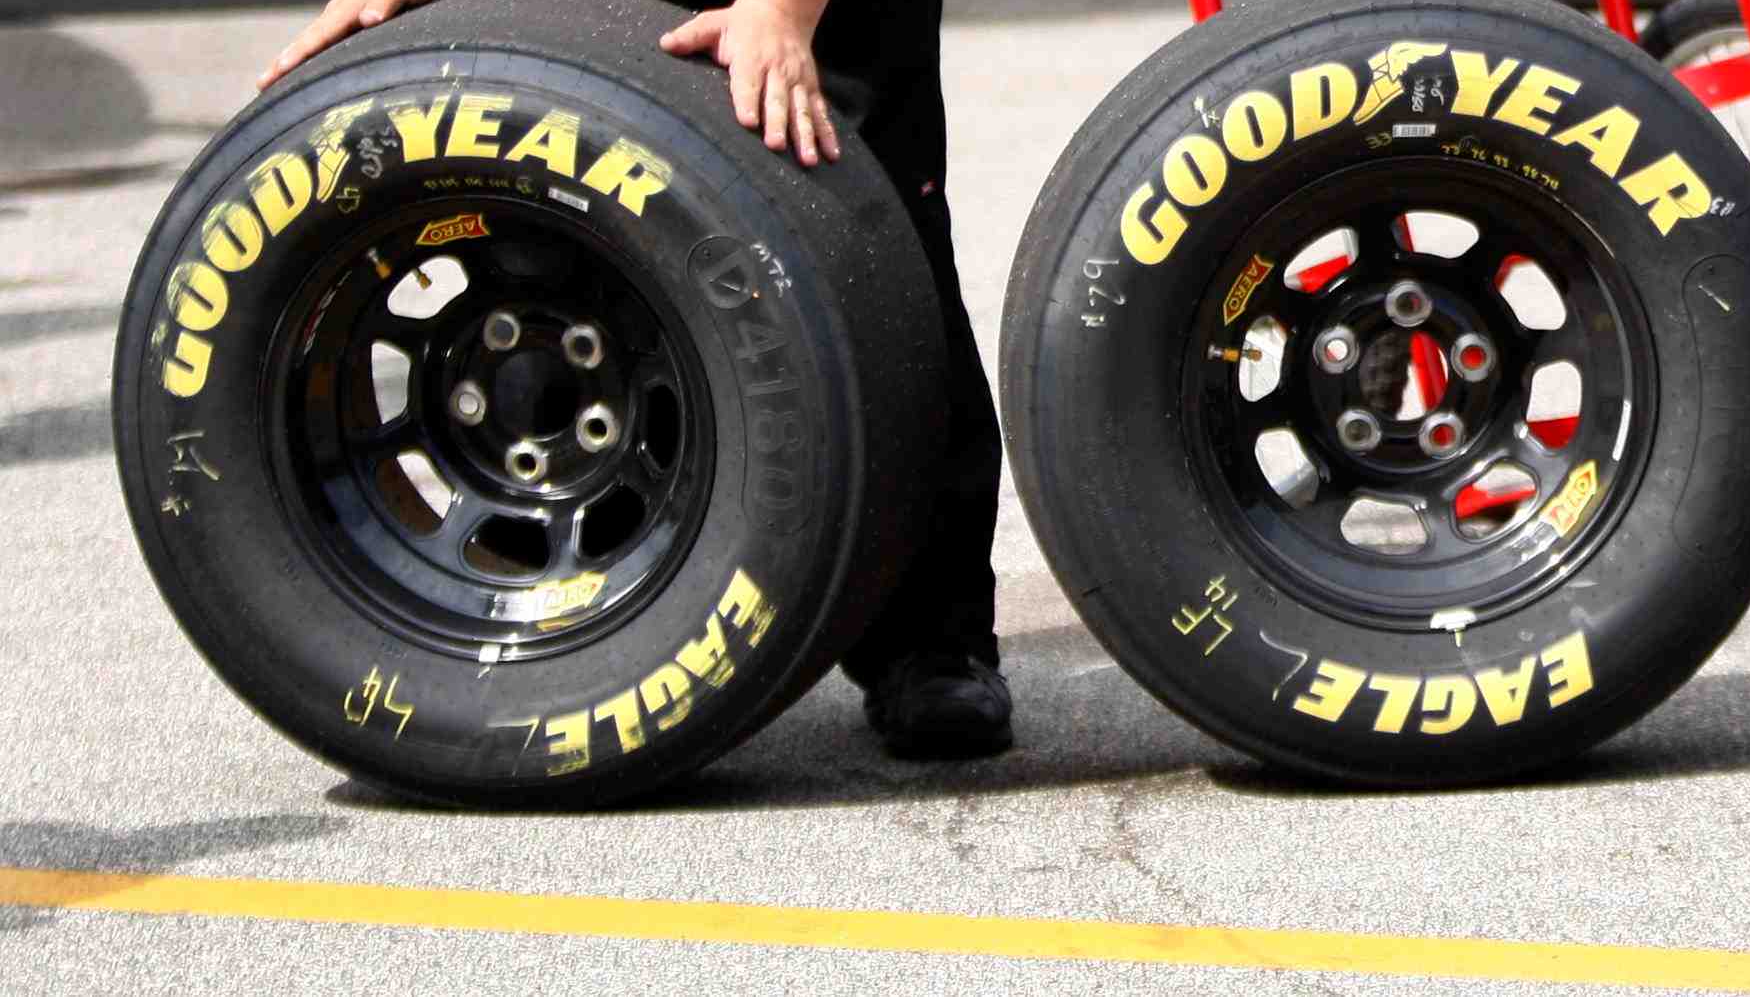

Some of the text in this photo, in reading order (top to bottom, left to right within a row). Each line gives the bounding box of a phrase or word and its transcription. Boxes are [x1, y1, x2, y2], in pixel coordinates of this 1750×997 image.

[546, 568, 776, 775] EAGLE
[1172, 603, 1233, 656] LF
[1294, 632, 1596, 735] EAGLE
